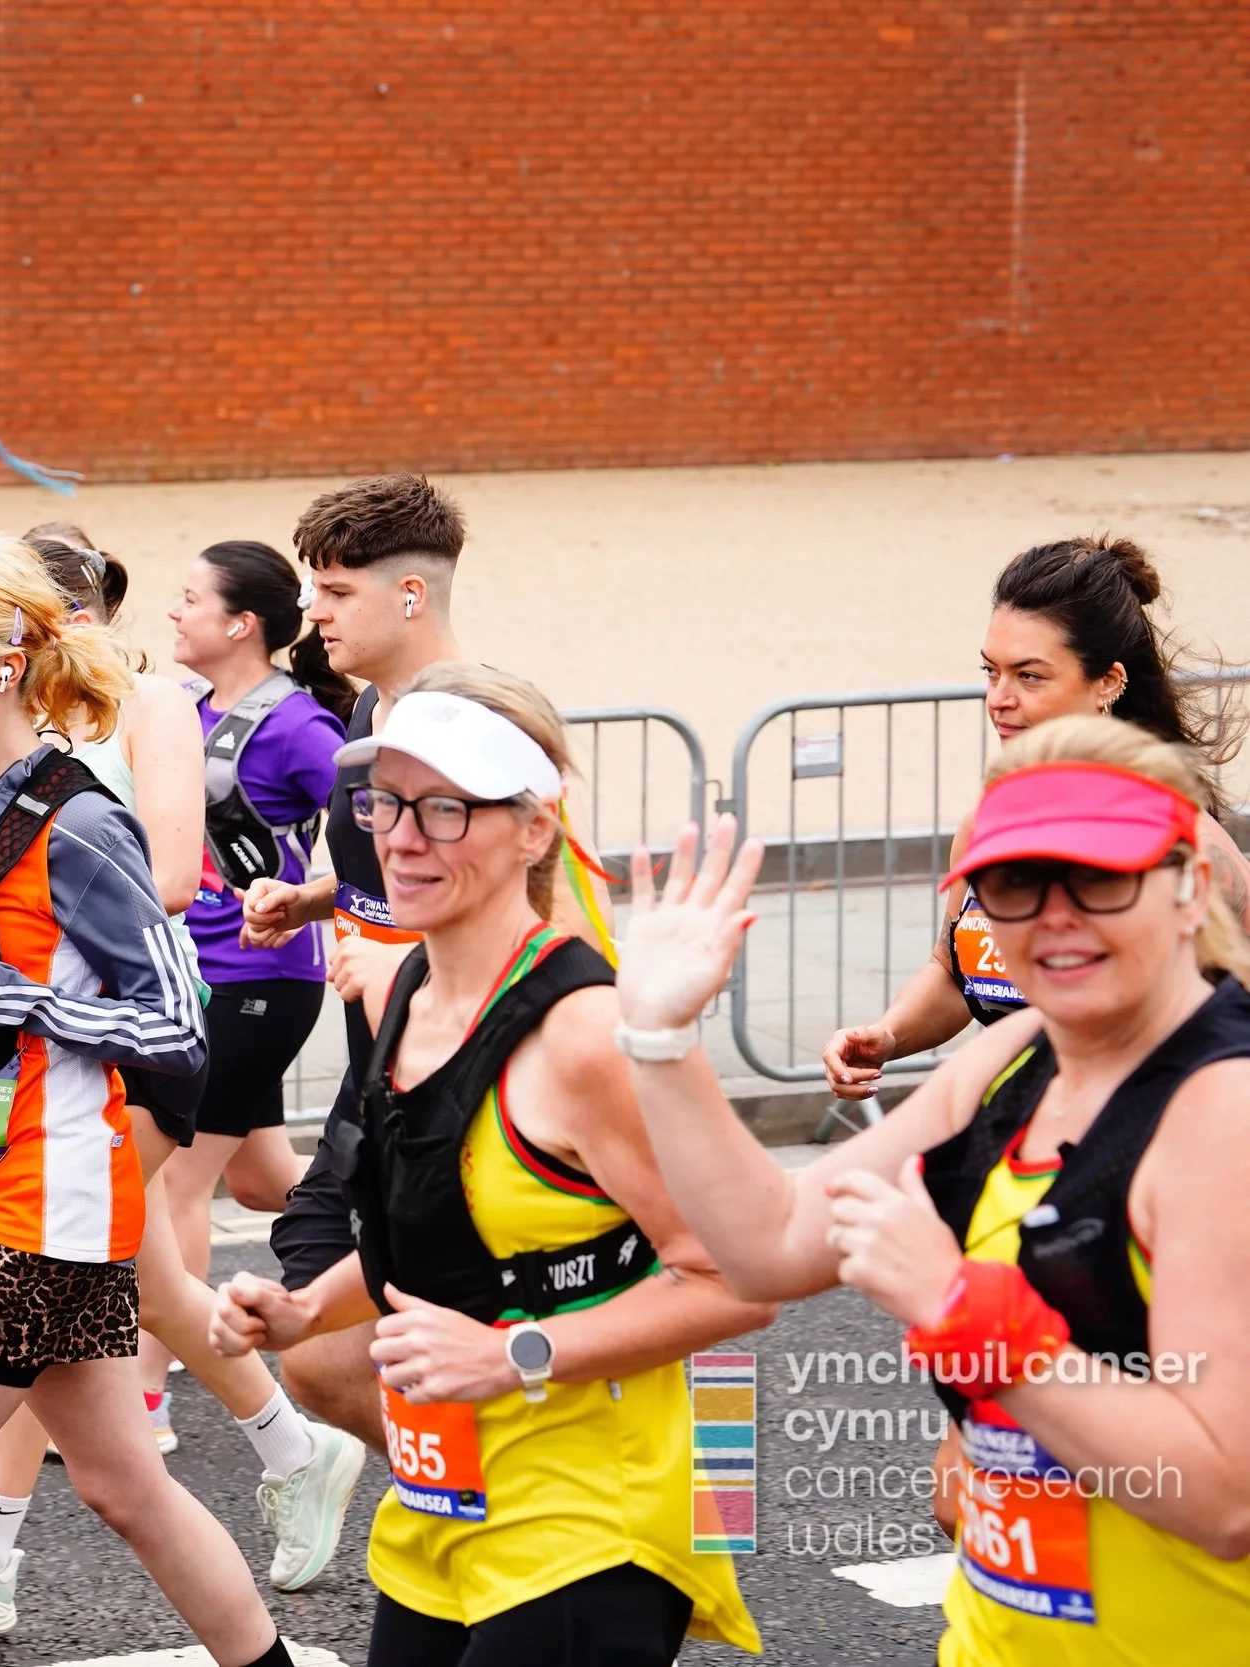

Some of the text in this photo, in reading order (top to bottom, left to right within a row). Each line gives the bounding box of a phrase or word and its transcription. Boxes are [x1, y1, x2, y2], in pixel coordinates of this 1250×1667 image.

[366, 898, 391, 913] SWAN
[336, 915, 361, 937] GWION
[547, 1253, 596, 1291] USZT
